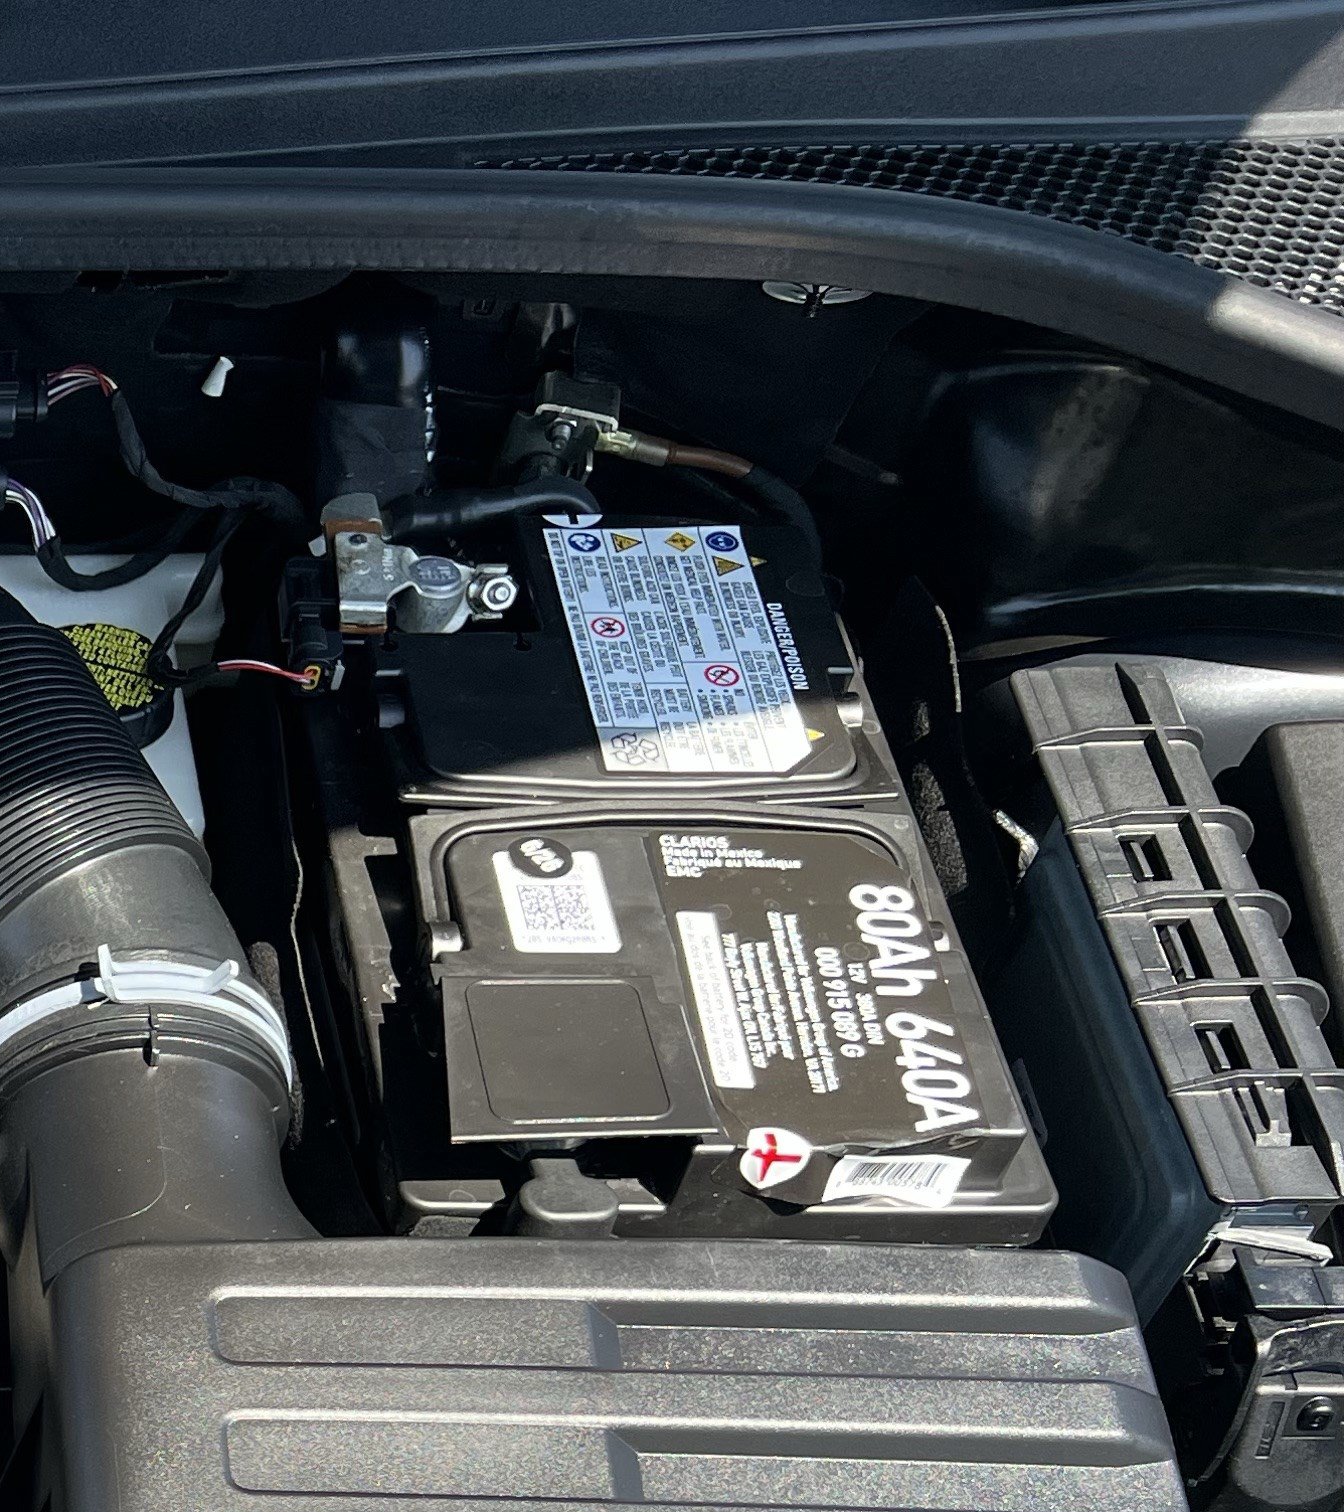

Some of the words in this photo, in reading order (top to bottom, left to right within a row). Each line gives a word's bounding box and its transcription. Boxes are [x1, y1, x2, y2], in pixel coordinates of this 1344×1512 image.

[767, 601, 809, 691] DANGER/POISON
[659, 834, 730, 848] CLARIOS
[662, 846, 698, 857] Made
[701, 848, 713, 857] in
[716, 848, 764, 858] Mexico
[663, 856, 722, 868] Fabriqué
[725, 859, 742, 867] au
[745, 858, 802, 870] Mexique
[666, 865, 702, 877] EMC
[848, 884, 938, 996] 80Ah
[813, 947, 844, 976] 000
[846, 962, 868, 983] 12V
[821, 979, 852, 1007] 915
[854, 992, 878, 1021] 380A
[829, 1011, 861, 1040] 089
[862, 1022, 884, 1044] DIN
[838, 1044, 865, 1057] G
[885, 1013, 980, 1132] 640A
